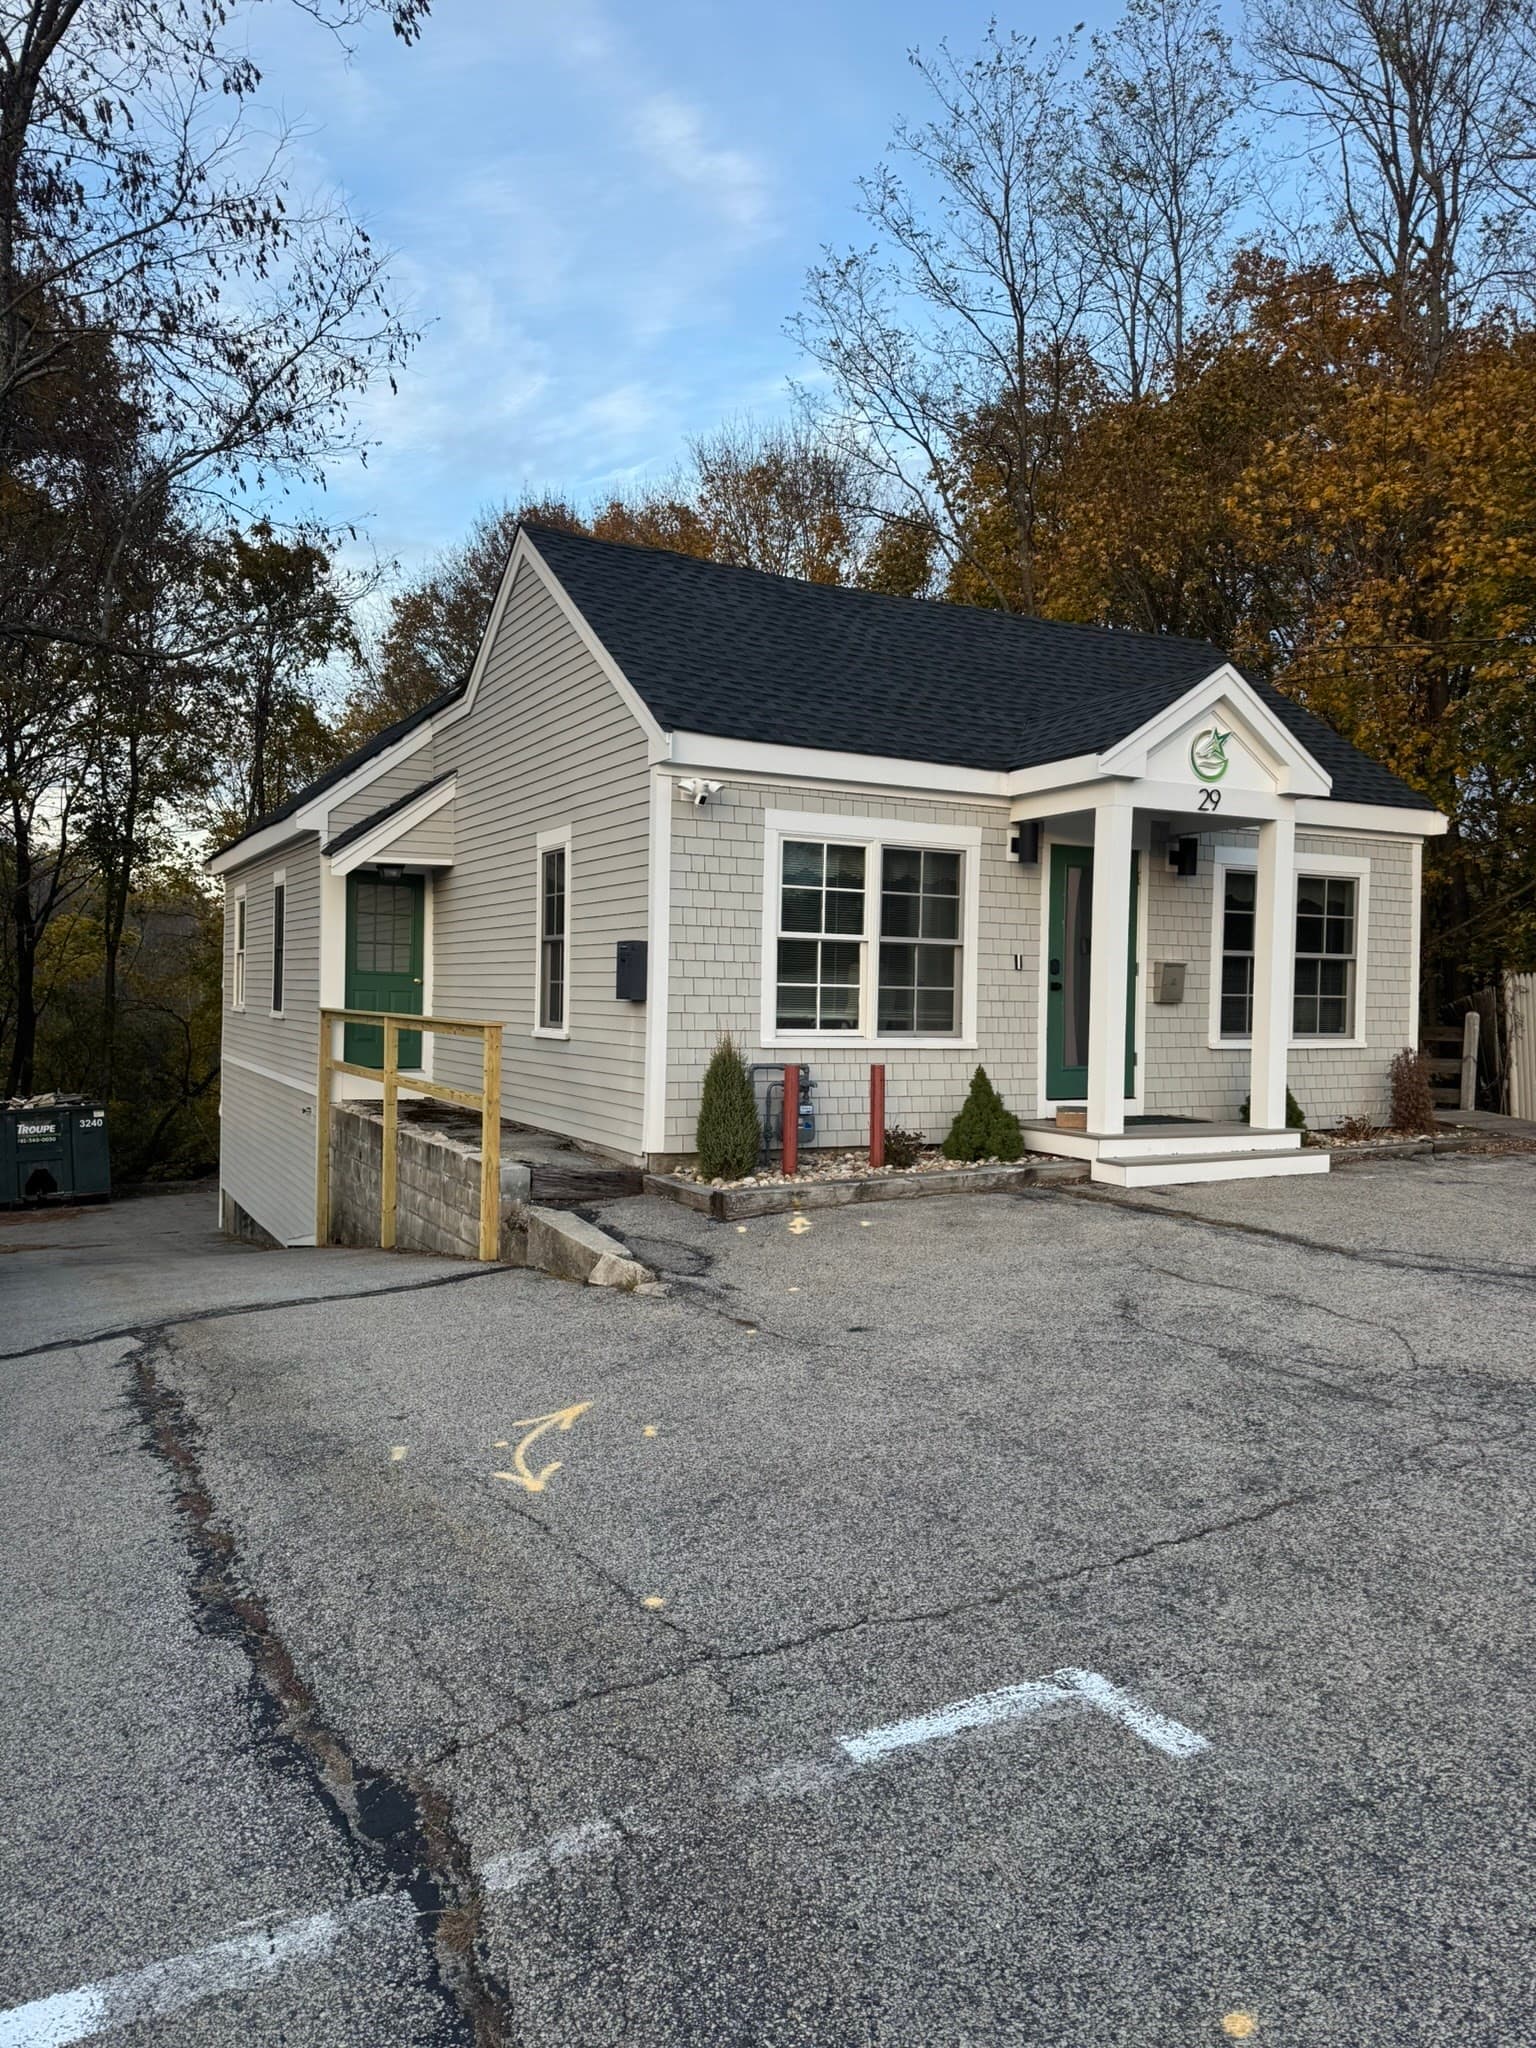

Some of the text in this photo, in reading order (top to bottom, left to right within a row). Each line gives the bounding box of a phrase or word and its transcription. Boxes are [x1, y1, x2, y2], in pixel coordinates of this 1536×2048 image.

[1197, 788, 1222, 812] 29
[79, 1119, 103, 1128] 3240
[17, 1124, 56, 1135] TROUPE
